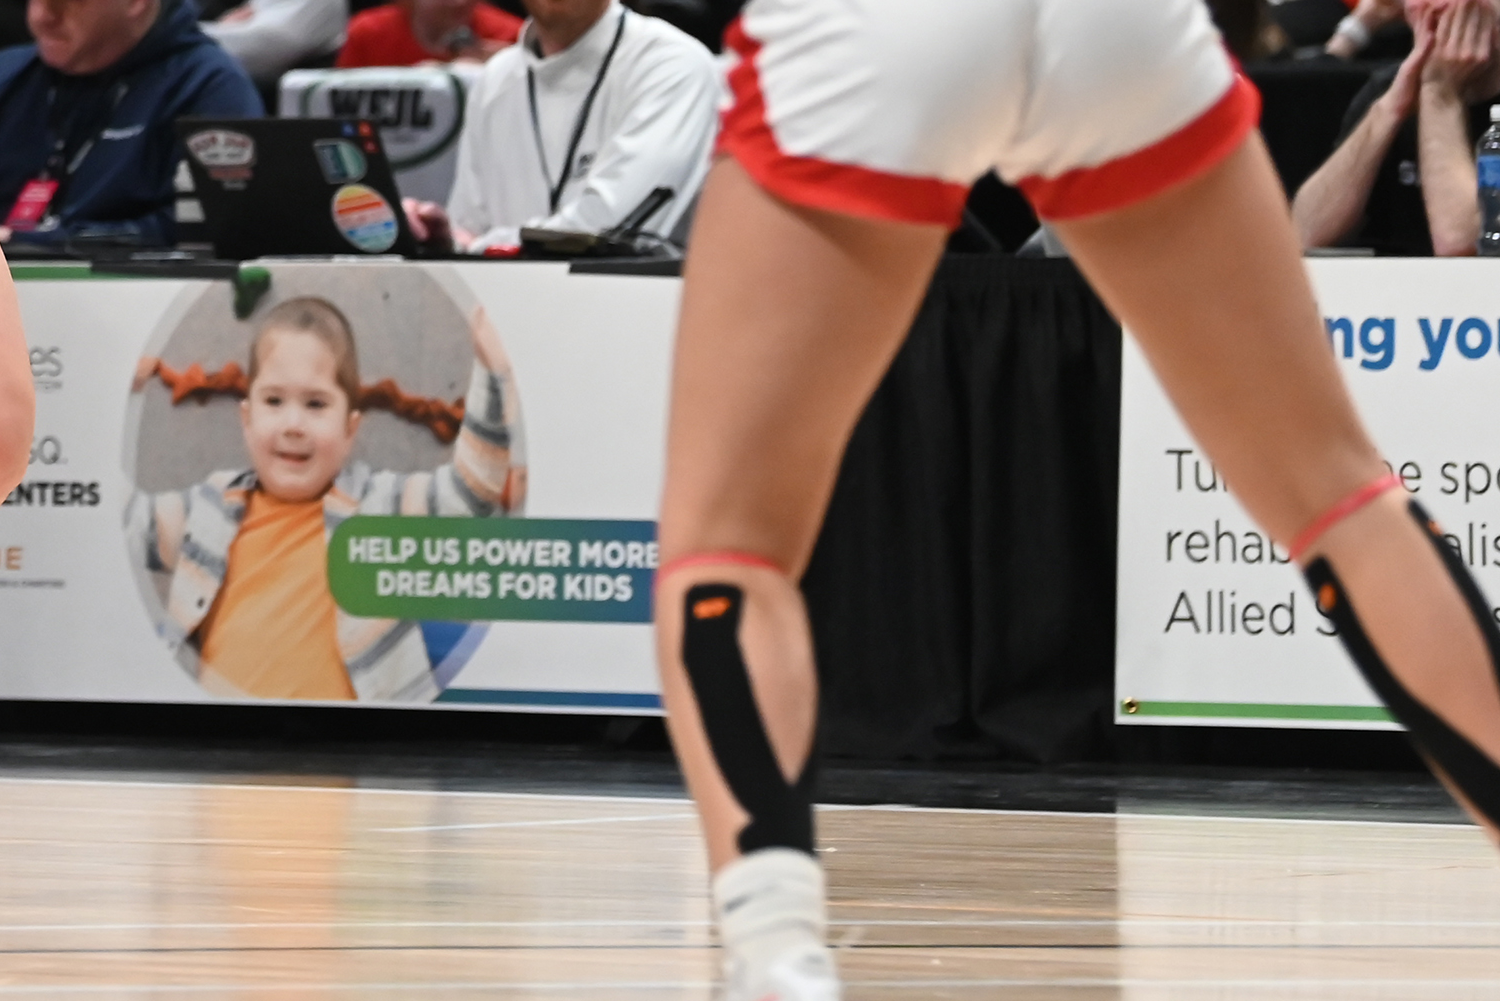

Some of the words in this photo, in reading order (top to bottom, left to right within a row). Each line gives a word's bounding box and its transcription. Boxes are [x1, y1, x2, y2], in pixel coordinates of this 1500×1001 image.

[1324, 317, 1396, 371] ng
[1417, 317, 1500, 371] yo
[2, 482, 100, 506] ENTERS
[1165, 449, 1228, 492] Tu
[1439, 461, 1500, 504] sp
[348, 537, 417, 565] HELP
[423, 538, 460, 565] US
[466, 538, 571, 567] POWER
[578, 541, 659, 569] MORE
[376, 569, 492, 599] DREAMS
[498, 571, 557, 600] FOR
[563, 574, 634, 602] KIDS
[1164, 590, 1296, 634] Allied
